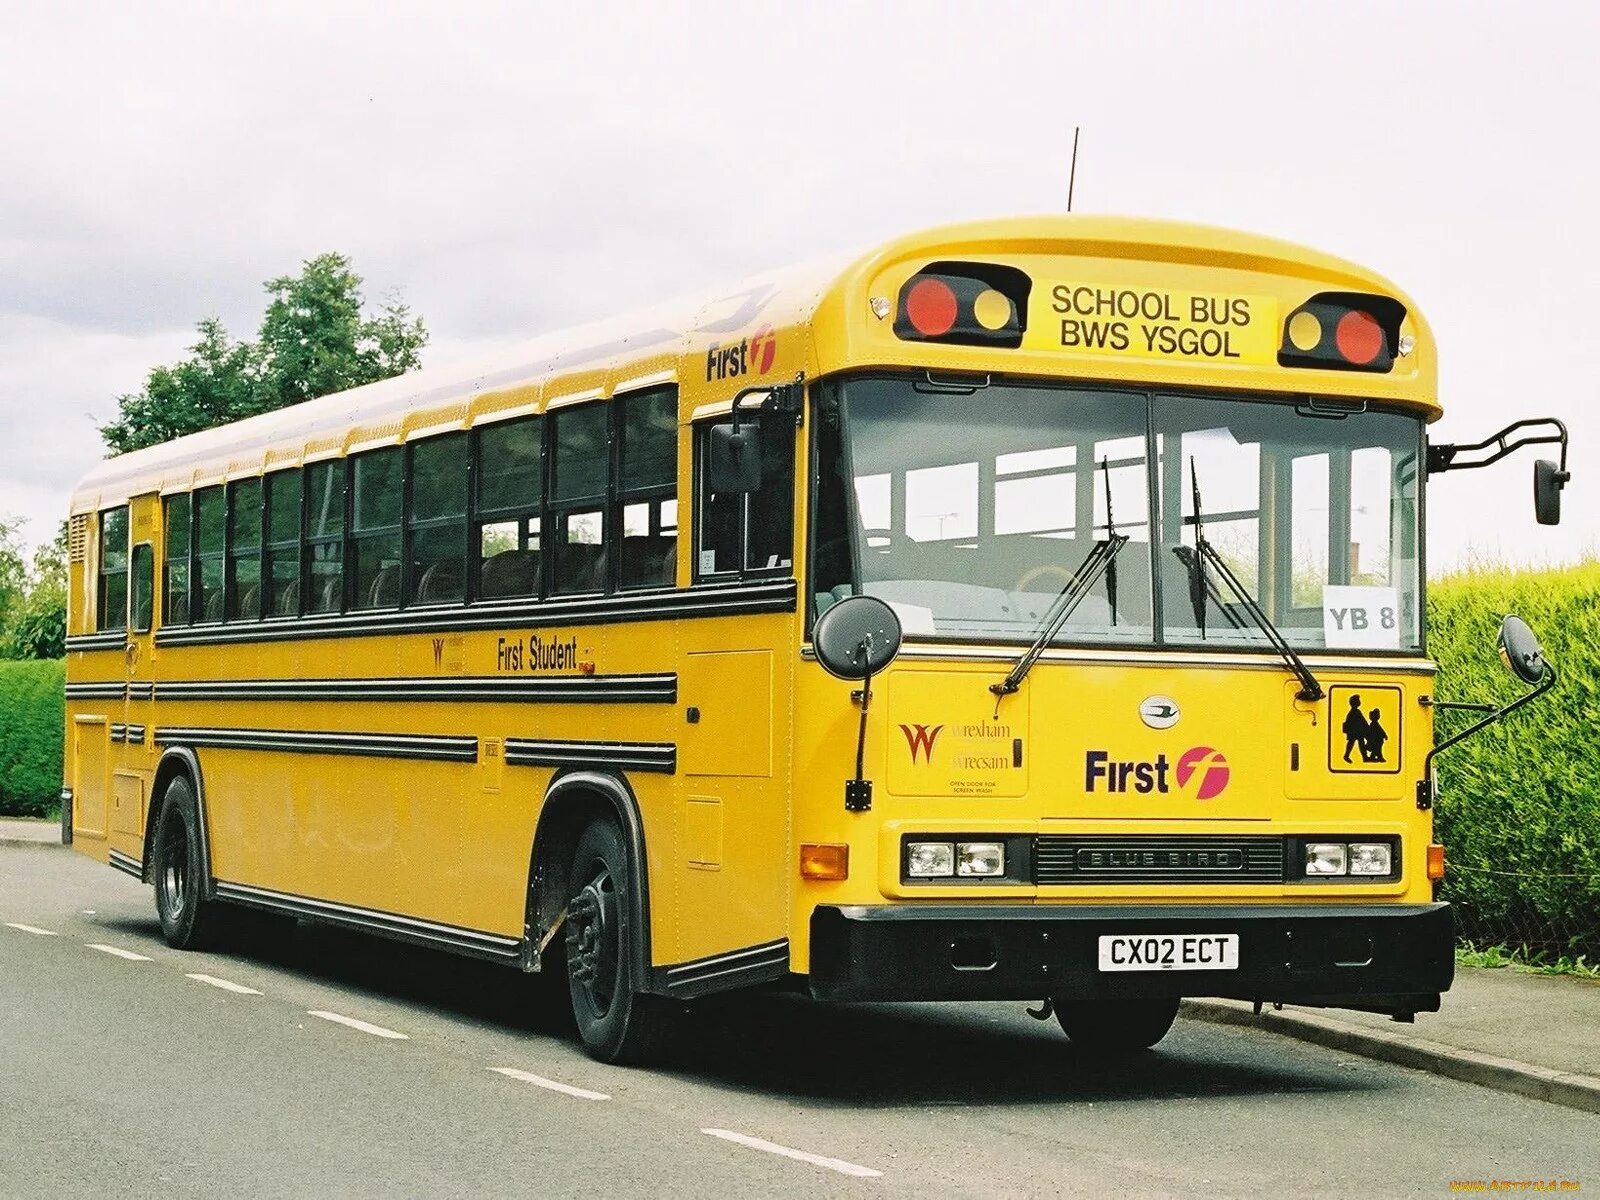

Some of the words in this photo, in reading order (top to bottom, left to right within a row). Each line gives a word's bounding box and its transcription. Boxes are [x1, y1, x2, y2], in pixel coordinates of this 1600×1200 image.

[1052, 284, 1181, 322] SCHOOL
[1190, 296, 1251, 327] BUS
[1061, 319, 1130, 351] BWS
[1141, 325, 1241, 358] YSGOL
[706, 337, 748, 382] First
[1329, 607, 1369, 630] YB
[1380, 606, 1396, 630] 8
[497, 637, 524, 671] First
[529, 634, 577, 671] Student
[1085, 750, 1169, 794] First
[1091, 853, 1155, 866] BLUE
[1169, 853, 1230, 866] BIRD
[1111, 938, 1175, 964] CX02
[1182, 937, 1229, 963] ECT
